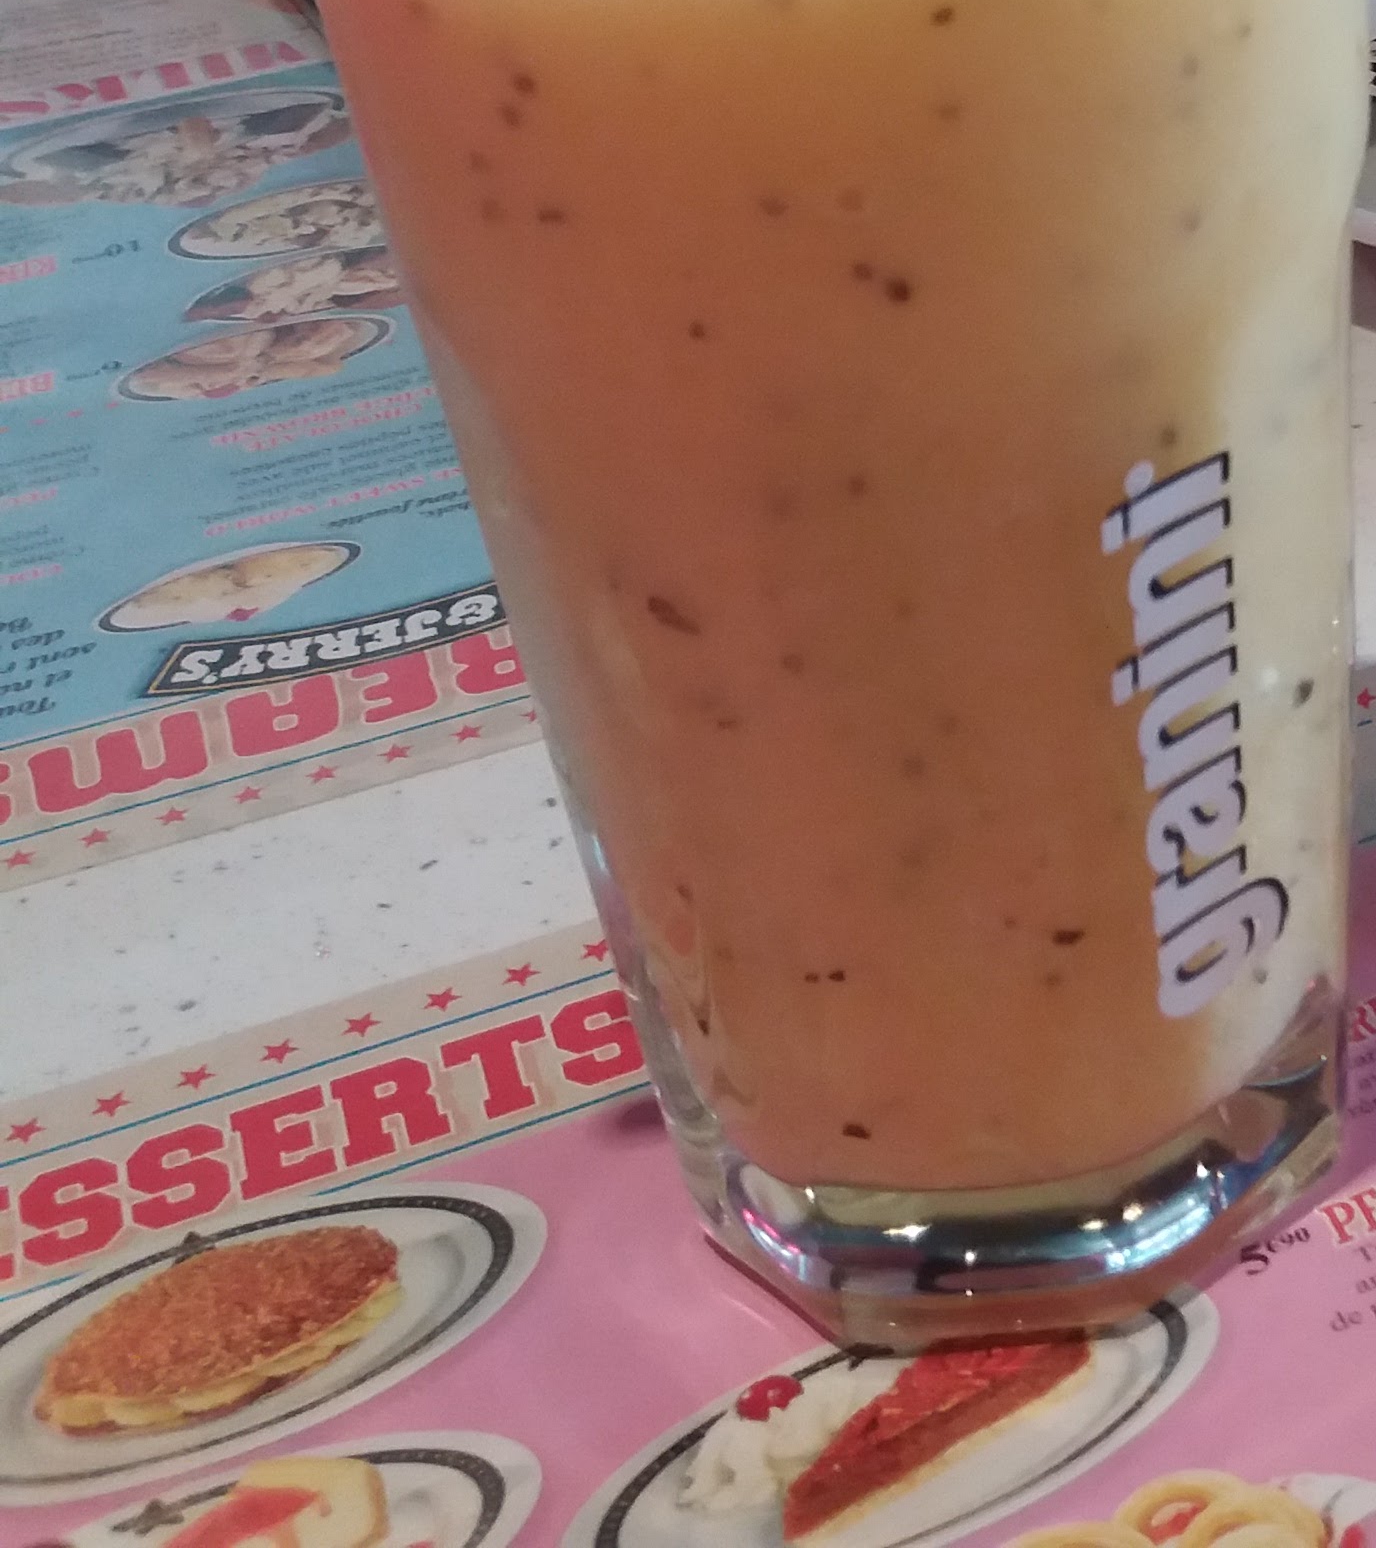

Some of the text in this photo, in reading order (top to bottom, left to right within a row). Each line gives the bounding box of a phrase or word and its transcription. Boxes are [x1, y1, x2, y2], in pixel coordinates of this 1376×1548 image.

[1100, 450, 1290, 1018] granini
[0, 988, 647, 1282] SSERTS
[1329, 1309, 1364, 1333] de
